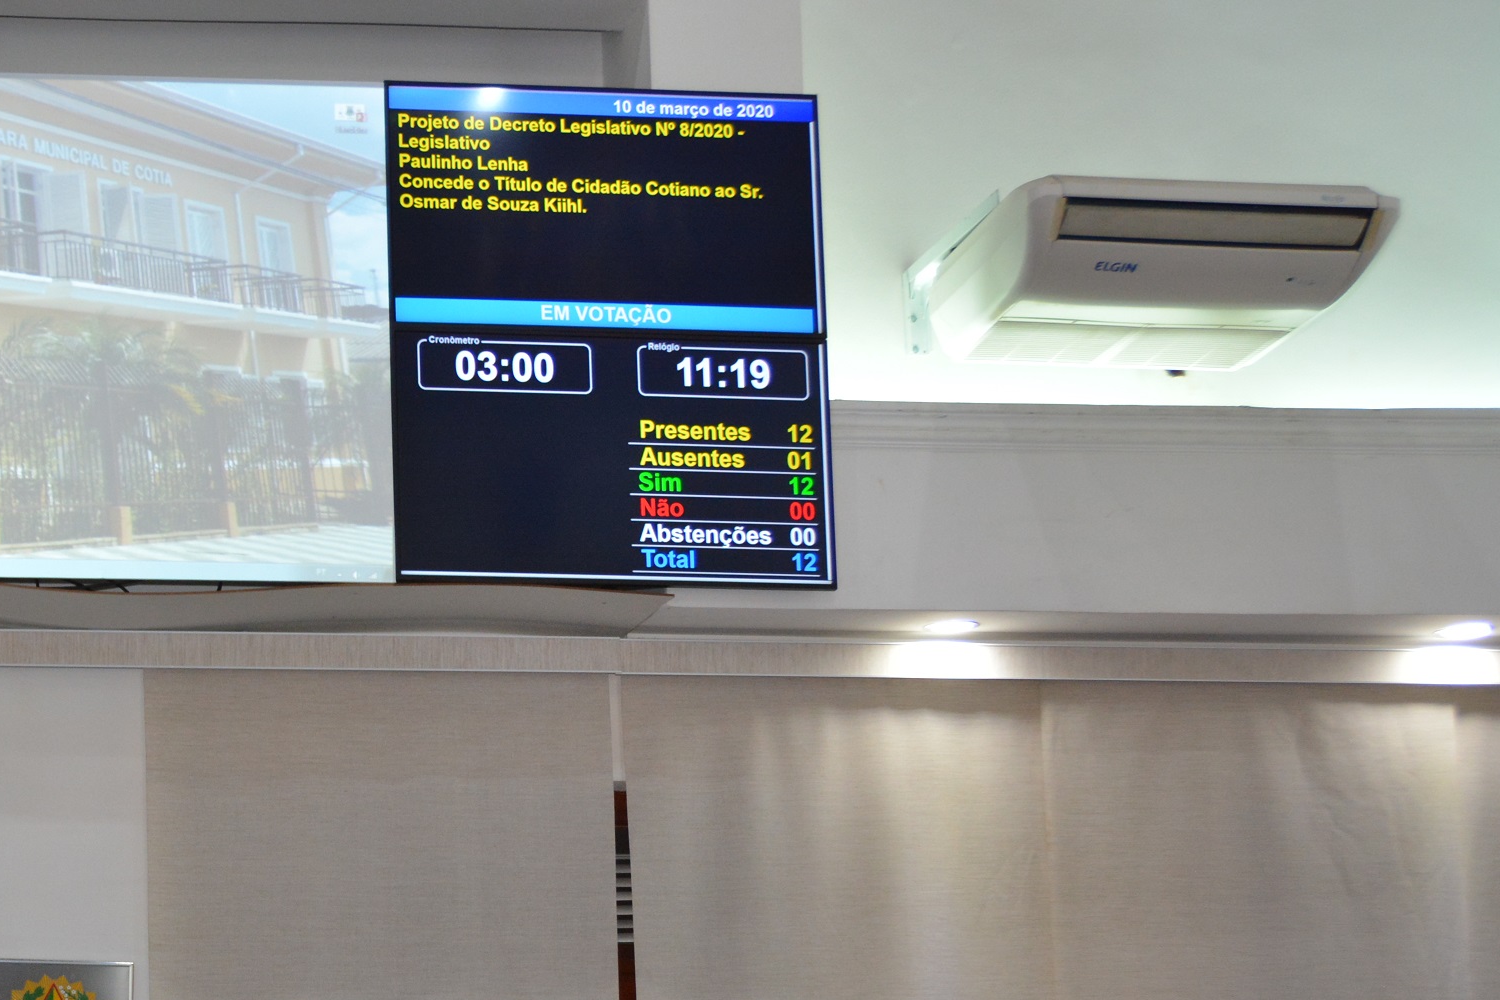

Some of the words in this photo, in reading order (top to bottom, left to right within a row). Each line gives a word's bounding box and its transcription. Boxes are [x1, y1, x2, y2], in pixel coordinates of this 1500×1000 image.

[614, 100, 631, 113] 10
[636, 101, 655, 113] de
[660, 105, 709, 118] março
[714, 104, 732, 116] de
[738, 104, 773, 117] 2020
[398, 113, 459, 131] Projeto
[464, 116, 484, 130] de
[489, 116, 556, 133] Decreto
[560, 119, 651, 137] Legislativo
[680, 122, 734, 138] 8/2020
[399, 133, 490, 152] Legislativo
[34, 138, 107, 170] MUNICIPAL
[112, 159, 130, 176] DE
[135, 165, 173, 186] COTIA
[399, 153, 473, 169] Paulinho
[477, 156, 528, 171] Lenha
[399, 173, 474, 190] Concede
[478, 179, 490, 190] o
[494, 176, 542, 192] Título
[546, 178, 567, 192] de
[572, 178, 642, 195] Cidadão
[646, 181, 711, 197] Cotiano
[715, 187, 736, 198] ao
[740, 184, 763, 199] Sr.
[400, 193, 457, 209] Osmar
[462, 195, 482, 210] de
[487, 196, 539, 212] Souza
[544, 198, 587, 213] Kiihl.
[1094, 261, 1138, 273] ELGIN
[541, 305, 569, 320] EM
[575, 304, 671, 325] VOTAÇÃO
[428, 335, 480, 345] Cronômetro
[647, 341, 680, 353] Relógio
[455, 350, 556, 383] 03:00
[677, 356, 773, 389] 11:19
[640, 420, 751, 441] Presentes
[788, 424, 813, 443] 12
[640, 447, 745, 468] Ausentes
[787, 451, 811, 470] 01
[639, 472, 682, 492] Sim
[789, 477, 814, 495] 12
[640, 498, 684, 517] Não
[790, 502, 816, 520] 00
[640, 525, 772, 548] Abstenções
[790, 528, 815, 546] 00
[641, 549, 695, 569] Total
[792, 552, 819, 572] 12
